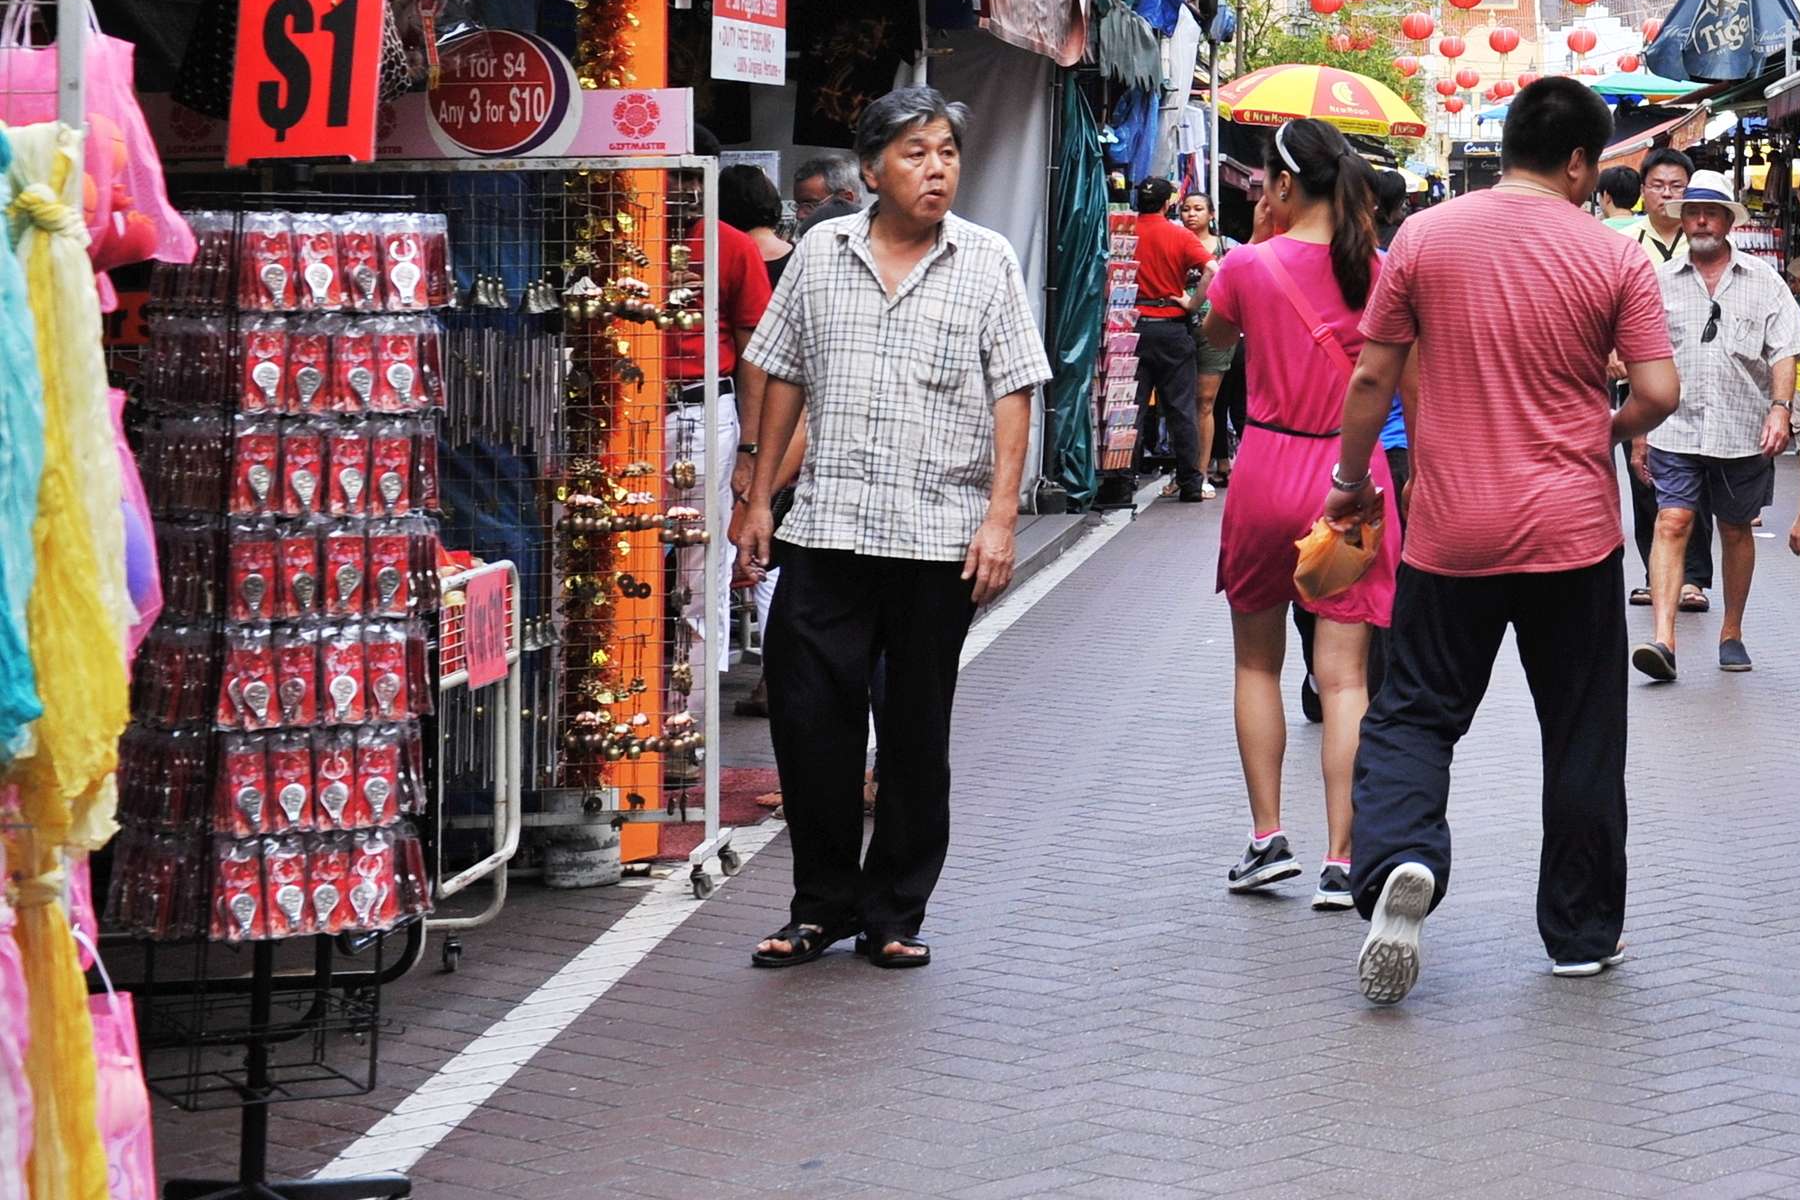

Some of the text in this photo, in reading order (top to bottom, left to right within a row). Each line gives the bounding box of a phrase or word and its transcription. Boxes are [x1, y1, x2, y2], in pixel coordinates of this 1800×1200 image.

[469, 53, 497, 78] for
[503, 52, 526, 81] $4
[439, 85, 545, 128] Any 3 for $10
